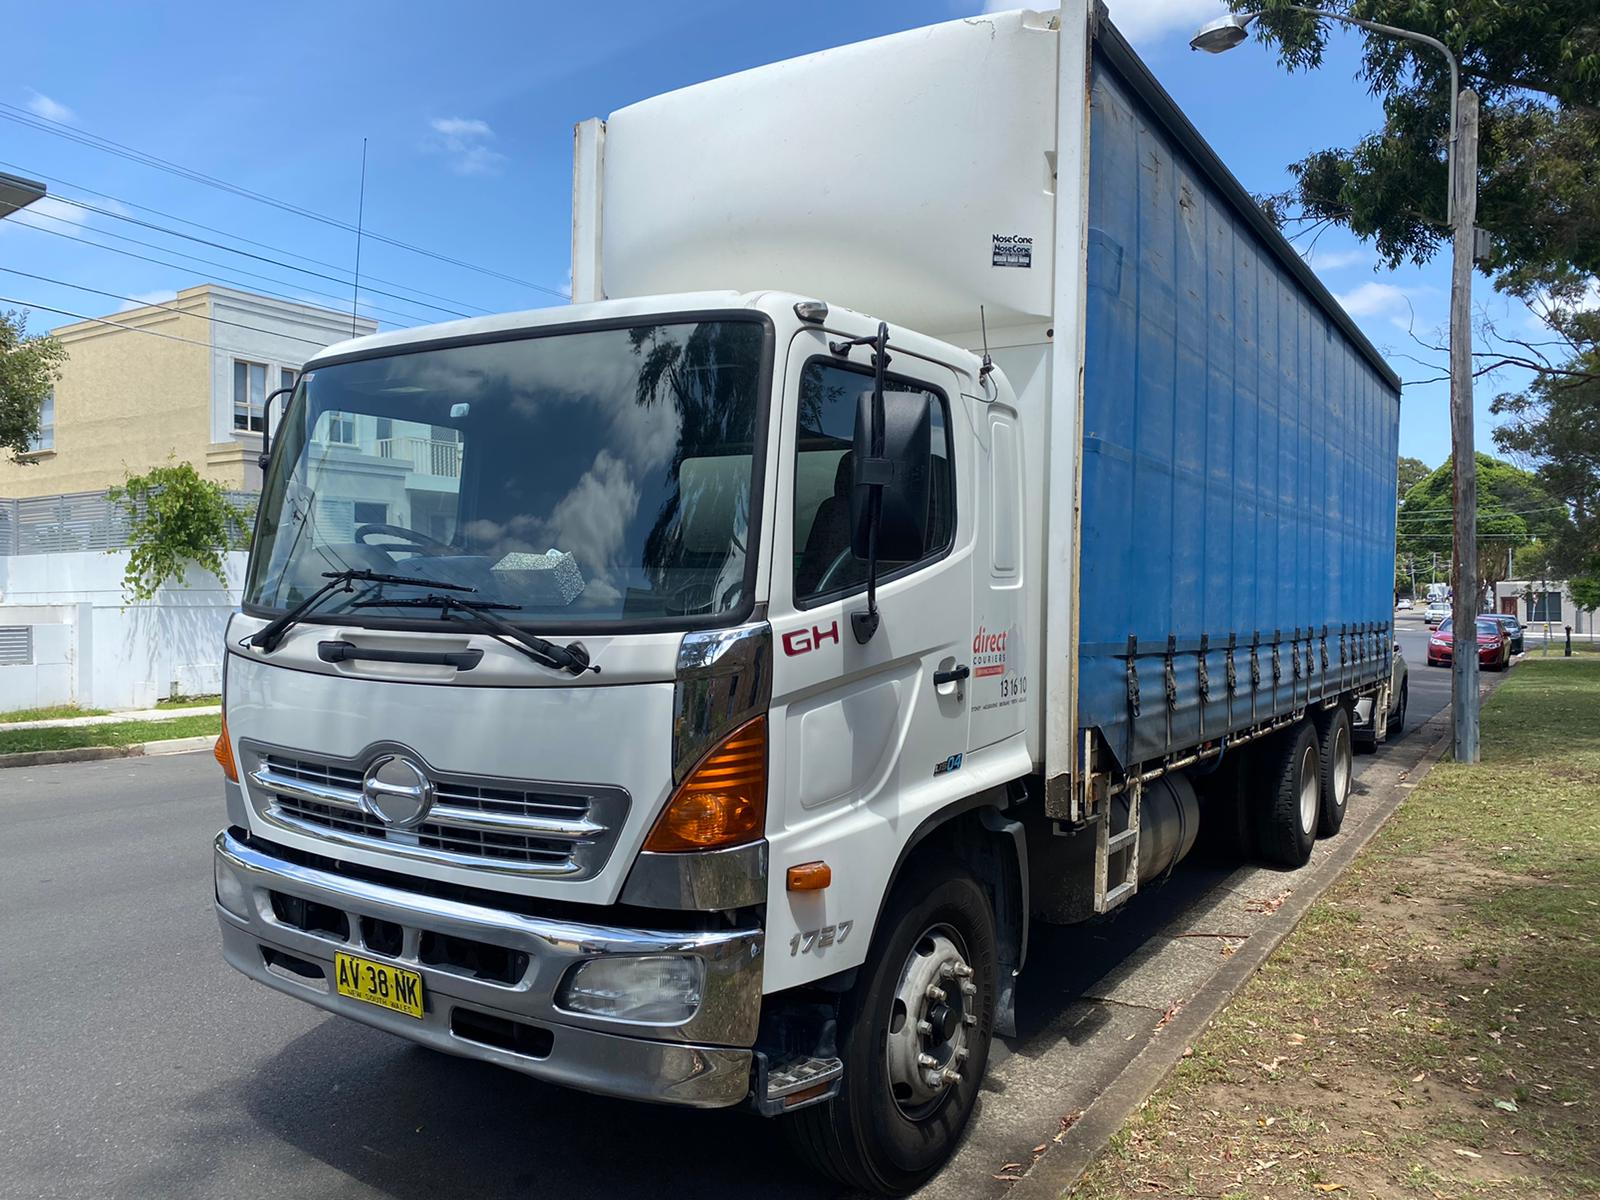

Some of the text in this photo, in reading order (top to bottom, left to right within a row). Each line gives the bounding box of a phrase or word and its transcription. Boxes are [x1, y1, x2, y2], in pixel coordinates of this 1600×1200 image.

[992, 234, 1033, 244] NoseCone
[994, 244, 1031, 253] NoseCone
[782, 621, 839, 657] GH
[973, 626, 1007, 653] direct
[973, 654, 1006, 665] COURIERS
[1000, 679, 1009, 698] 13
[1011, 677, 1018, 696] 16
[790, 920, 854, 957] 1727
[340, 959, 418, 1008] AV 38 NK
[365, 993, 388, 1005] SOUTH
